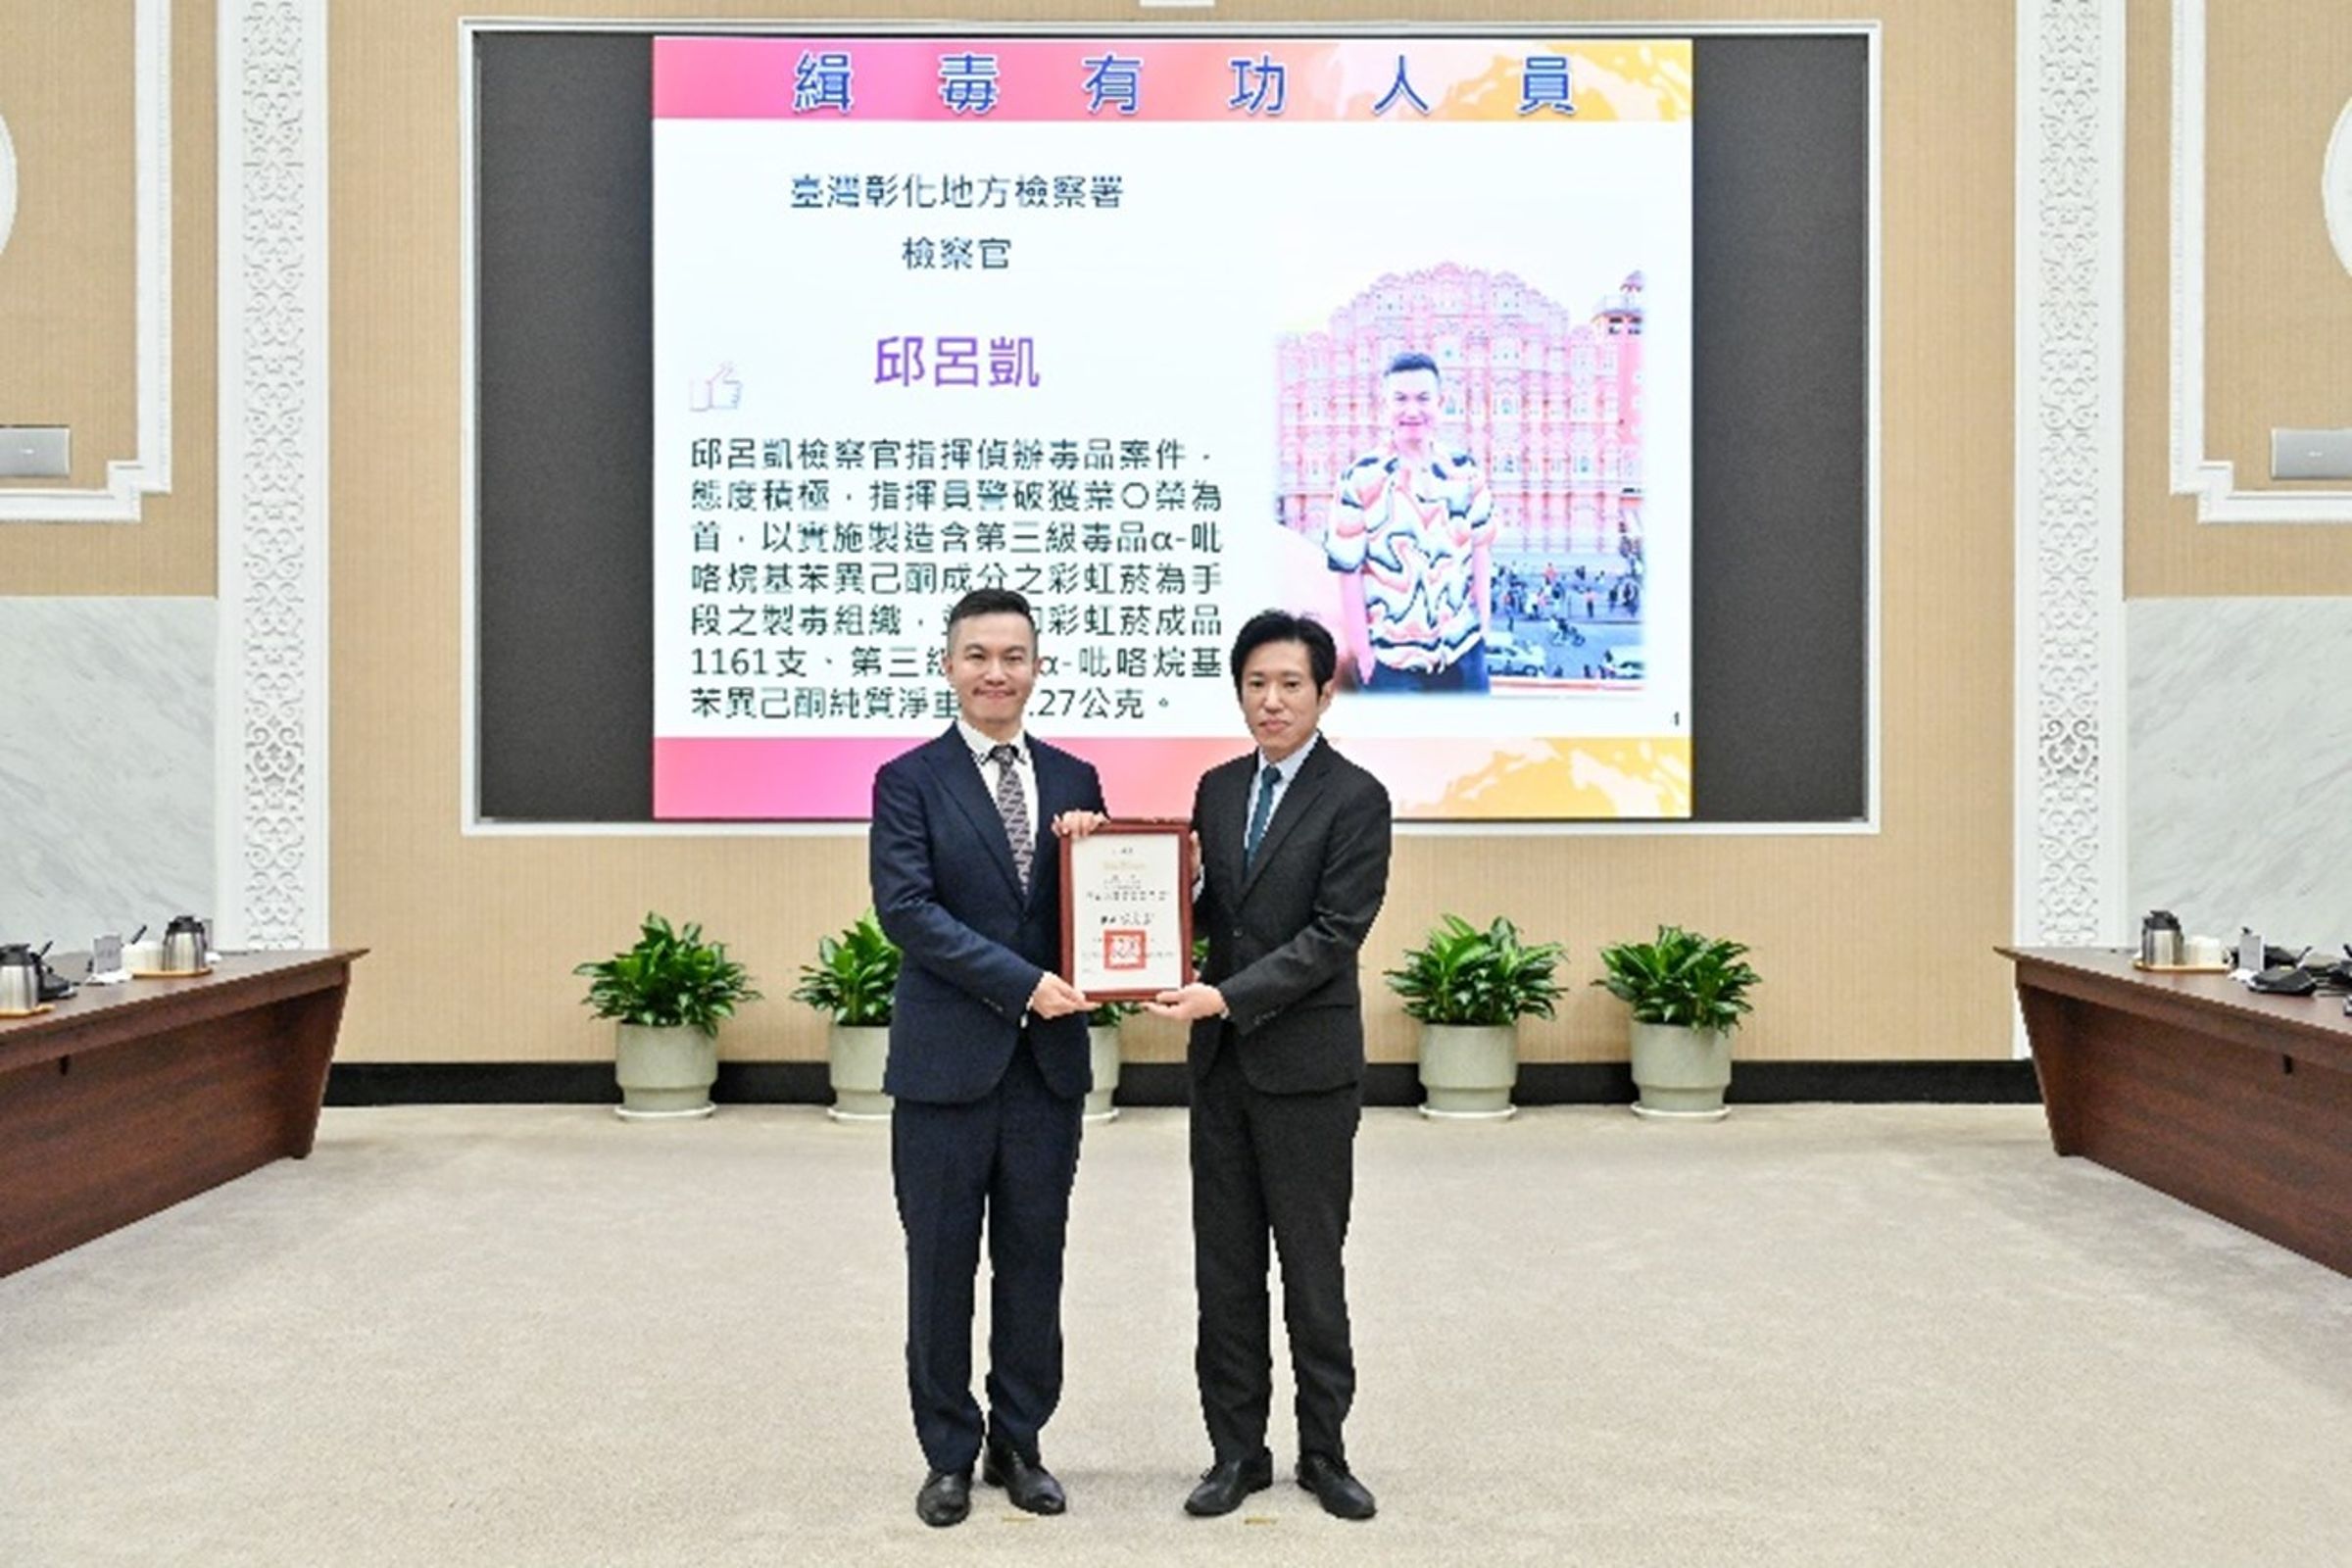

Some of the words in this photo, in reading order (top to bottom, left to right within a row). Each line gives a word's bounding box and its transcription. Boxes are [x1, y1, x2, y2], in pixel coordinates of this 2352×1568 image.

[790, 173, 1124, 209] 臺灣彰化地方檢察署
[902, 236, 1012, 270] 檢察官
[874, 335, 1041, 387] 邱呂凱
